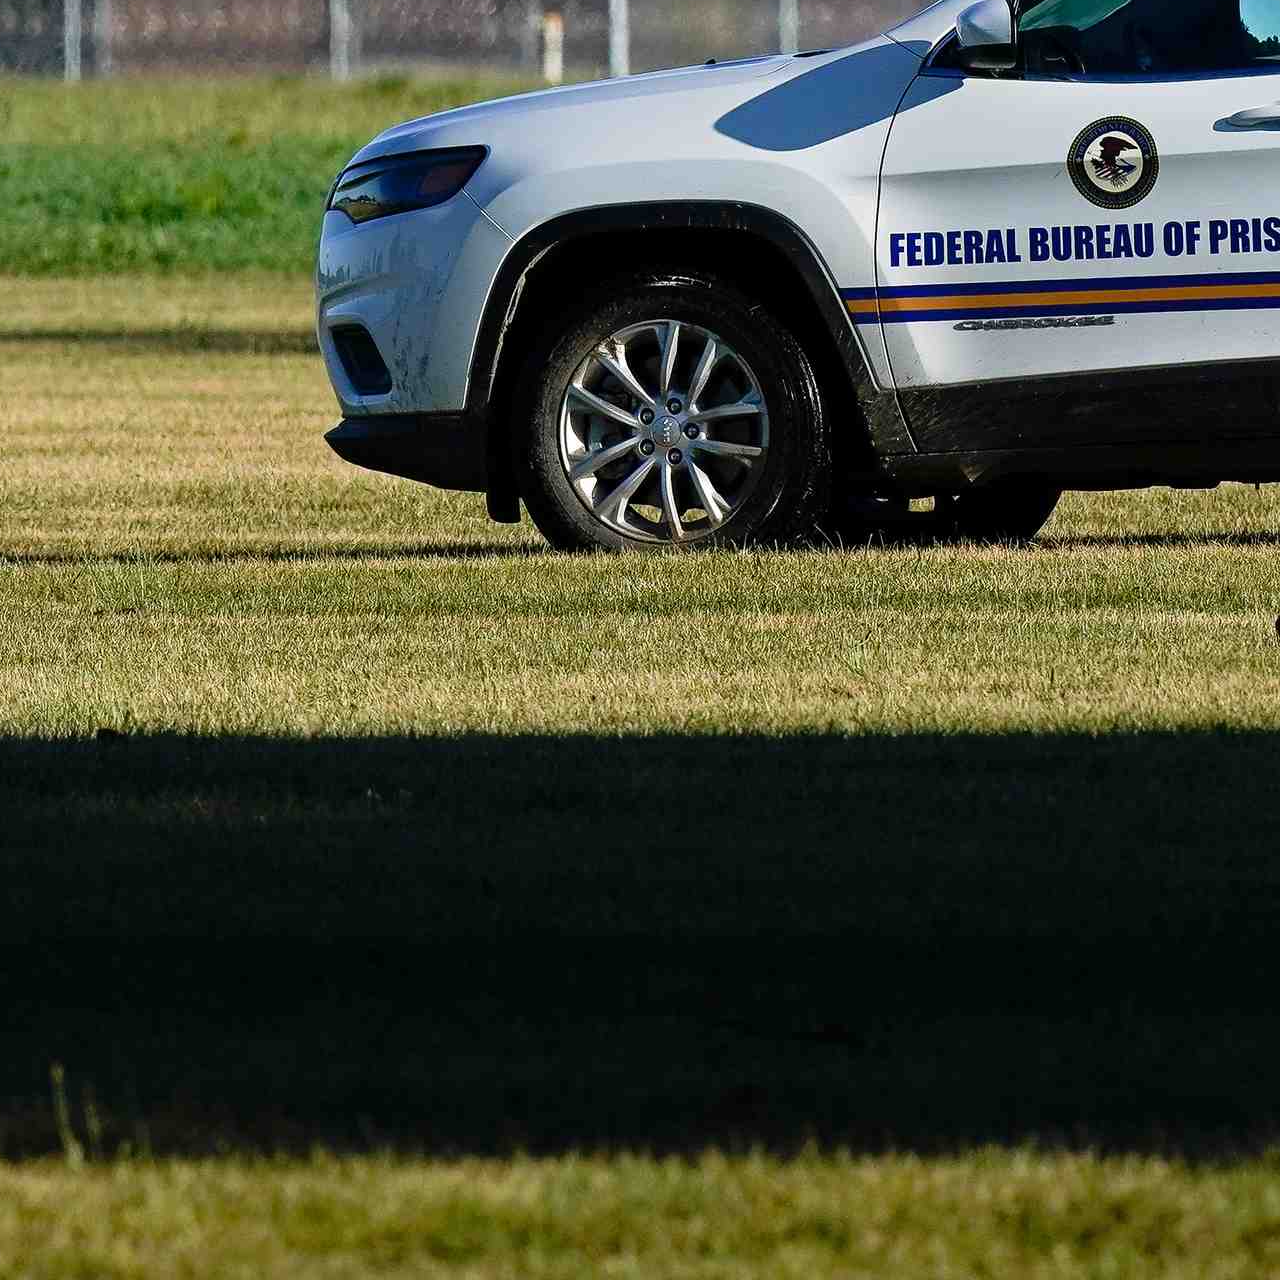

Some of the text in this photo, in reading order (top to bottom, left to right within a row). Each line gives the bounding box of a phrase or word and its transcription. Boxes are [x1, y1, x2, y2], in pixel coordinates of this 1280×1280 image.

[889, 228, 1022, 267] FEDERAL
[1029, 223, 1155, 262] BUREAU
[1163, 221, 1201, 257] OF
